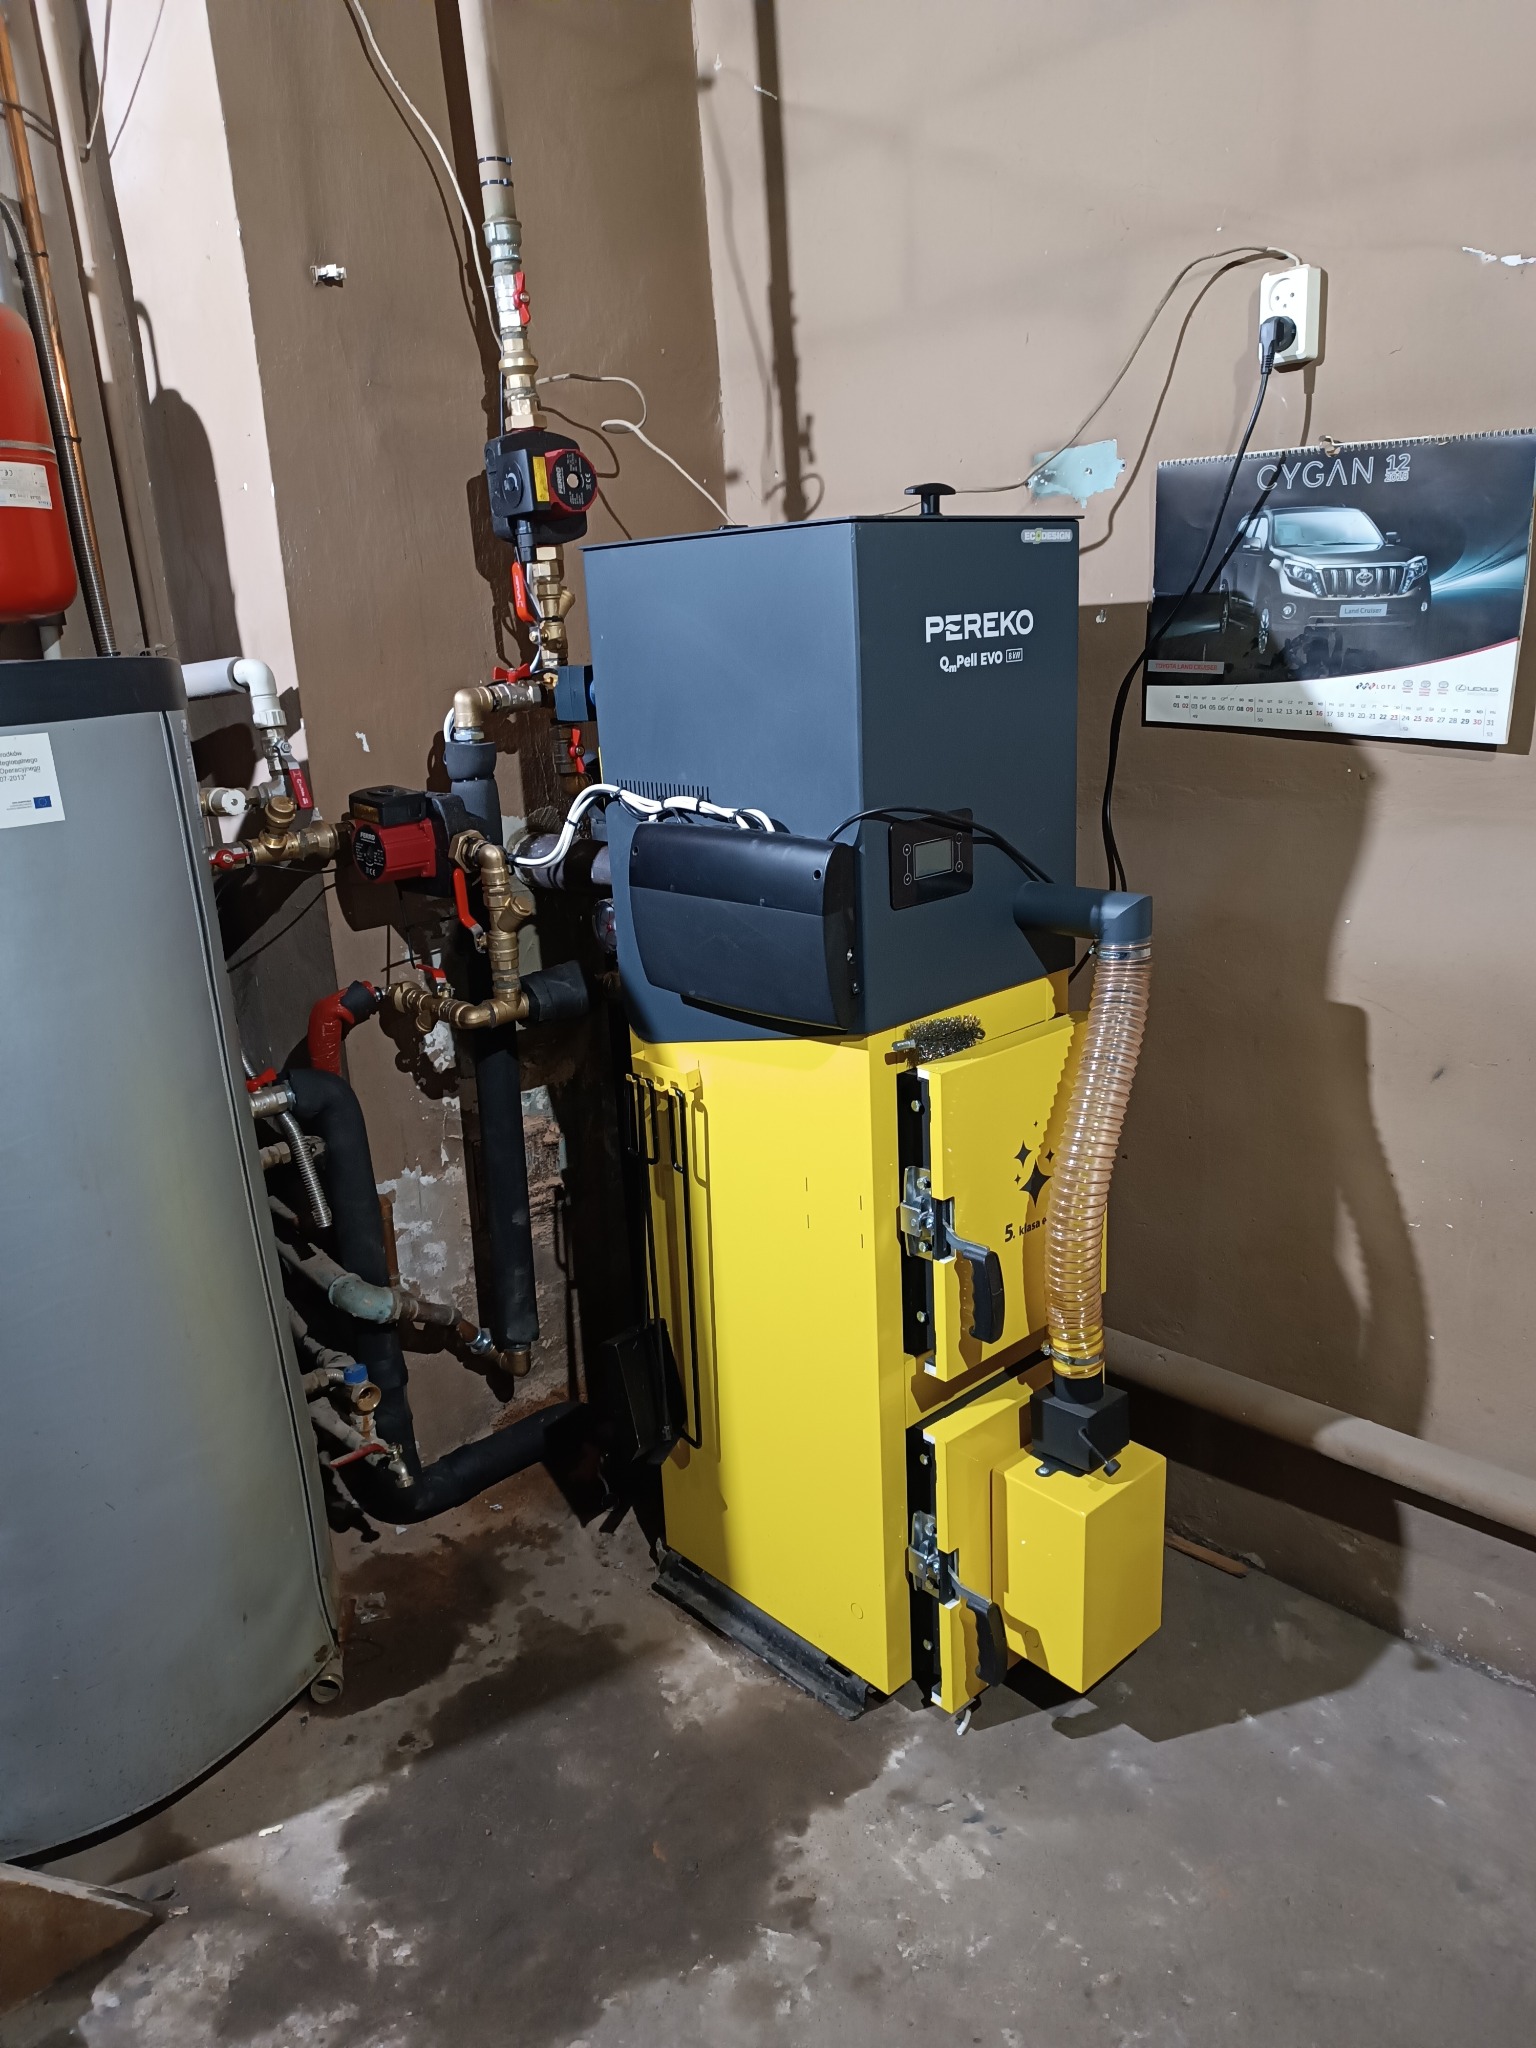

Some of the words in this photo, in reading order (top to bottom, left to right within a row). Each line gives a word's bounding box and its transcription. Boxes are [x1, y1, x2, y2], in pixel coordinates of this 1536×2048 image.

[1256, 456, 1374, 491] CYGAN
[1386, 453, 1411, 472] 12
[1024, 530, 1071, 542] ECODESIGN
[925, 609, 1034, 643] PEREKO
[980, 650, 1003, 666] EVO
[1004, 1222, 1015, 1243] 5.
[1018, 1219, 1041, 1236] klasa
